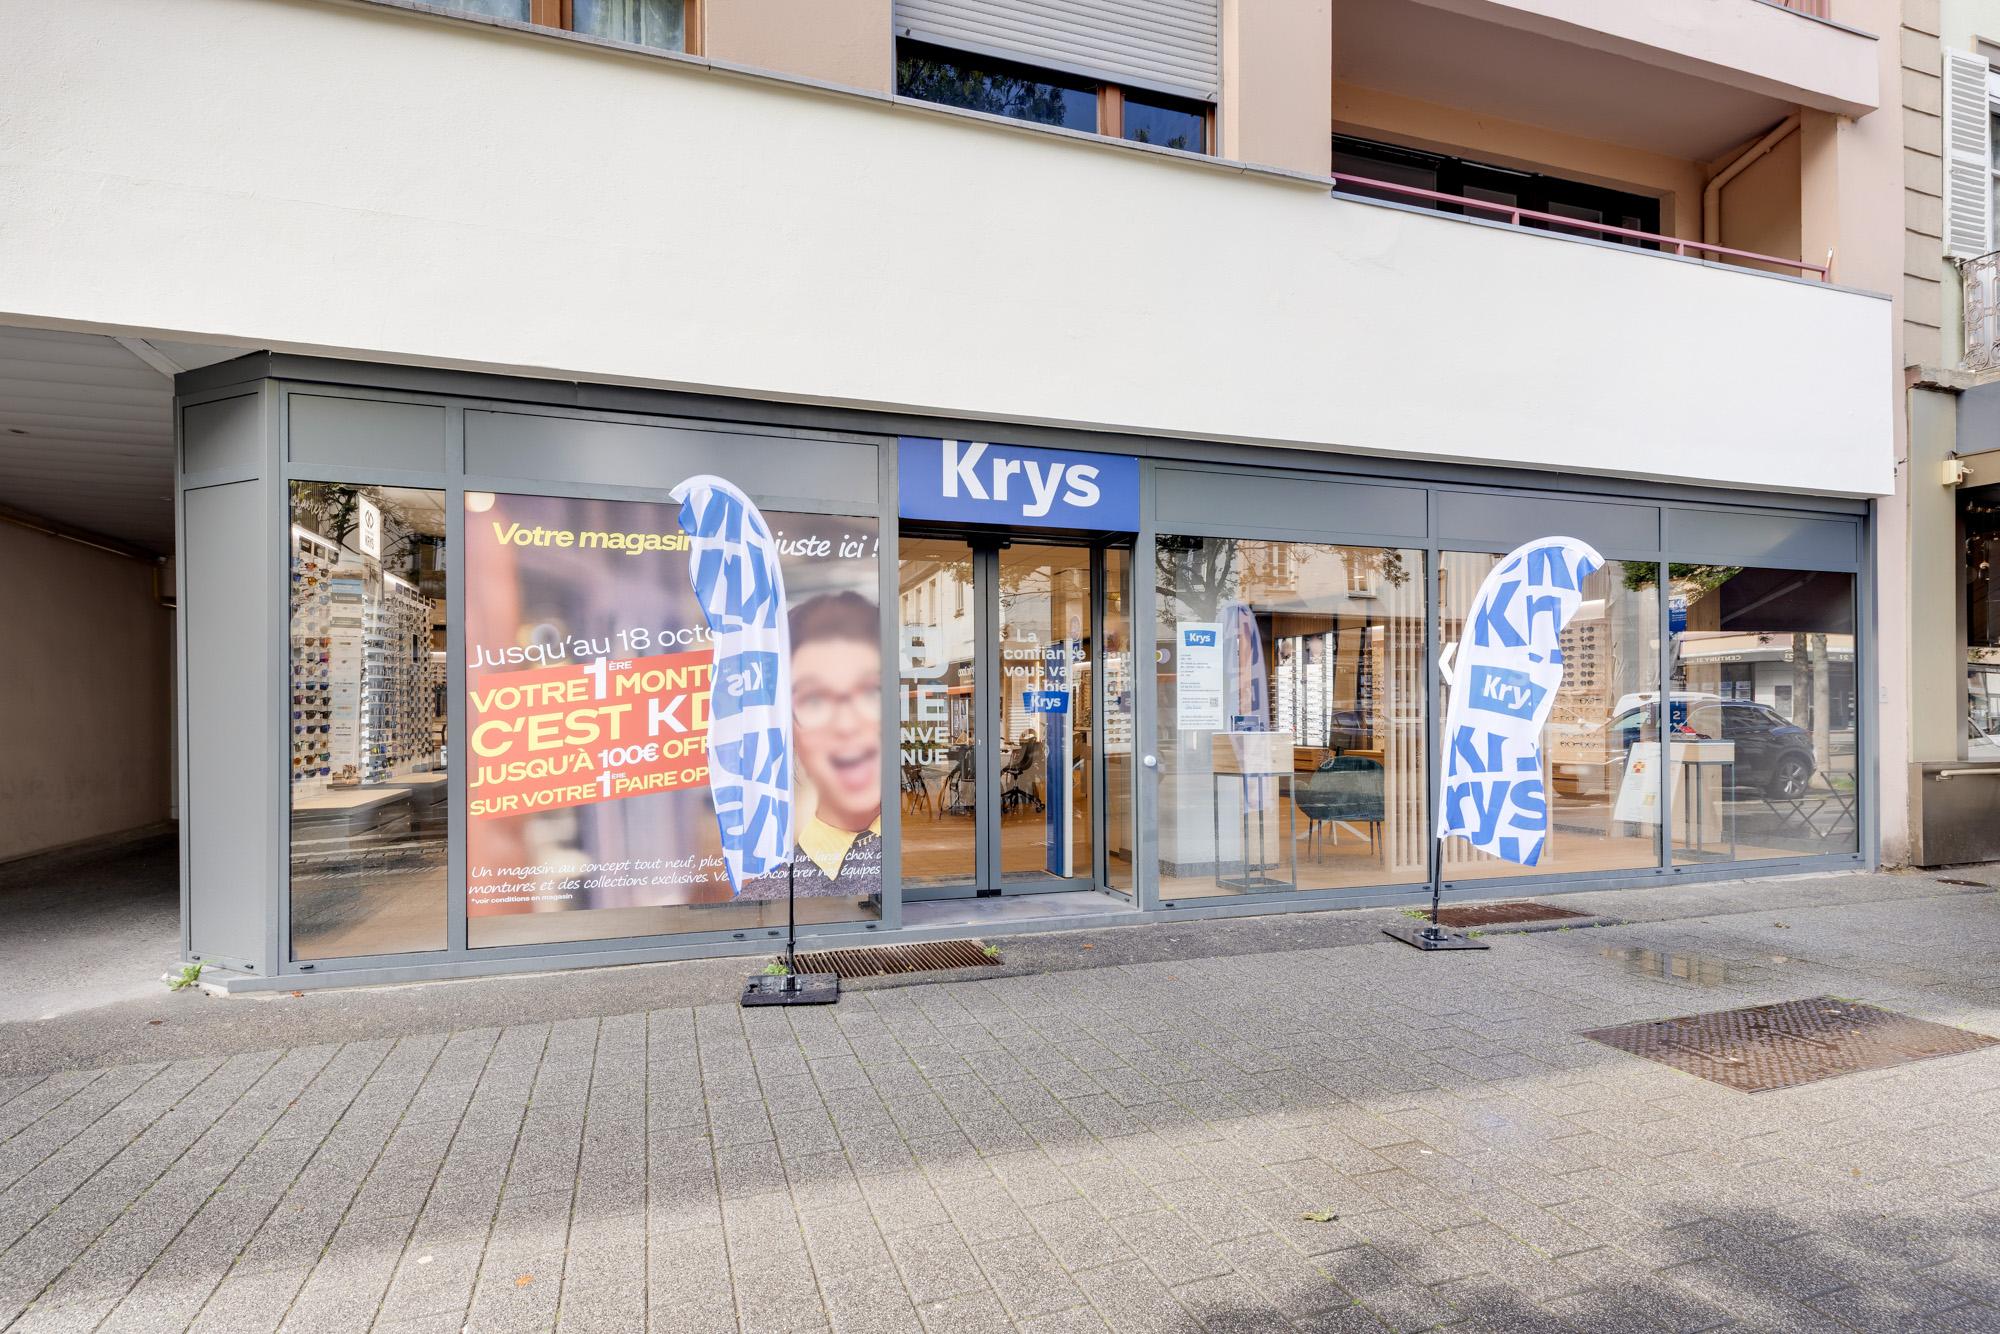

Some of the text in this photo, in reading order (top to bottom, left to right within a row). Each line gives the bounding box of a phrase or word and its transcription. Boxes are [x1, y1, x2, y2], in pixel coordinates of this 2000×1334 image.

[942, 439, 1101, 517] Krys
[492, 522, 574, 547] Votre
[838, 534, 866, 558] ici
[616, 627, 651, 652] 18
[1016, 629, 1037, 643] La
[1189, 632, 1211, 644] Krys
[1004, 666, 1045, 677] vous
[469, 678, 589, 713] VOTRE
[1031, 694, 1061, 710] Krys
[1482, 673, 1532, 710] Kry
[1672, 710, 1681, 720] 2
[901, 726, 949, 744] NVE
[598, 743, 659, 769] 100€
[901, 748, 949, 766] NUE
[469, 795, 519, 816] SUR
[521, 783, 597, 808] VOTRE
[614, 771, 678, 794] PAIRE
[471, 865, 493, 878] Un
[497, 862, 555, 881] magasin
[580, 859, 631, 876] concept
[634, 855, 661, 870] tout
[664, 854, 696, 871] neuf,
[845, 848, 874, 861] choix
[468, 881, 536, 895] montures
[540, 878, 554, 891] et
[558, 876, 580, 890] des
[583, 872, 648, 889] collections
[840, 863, 881, 879] équipes
[490, 895, 530, 904] conditions
[542, 893, 573, 904] magasin
